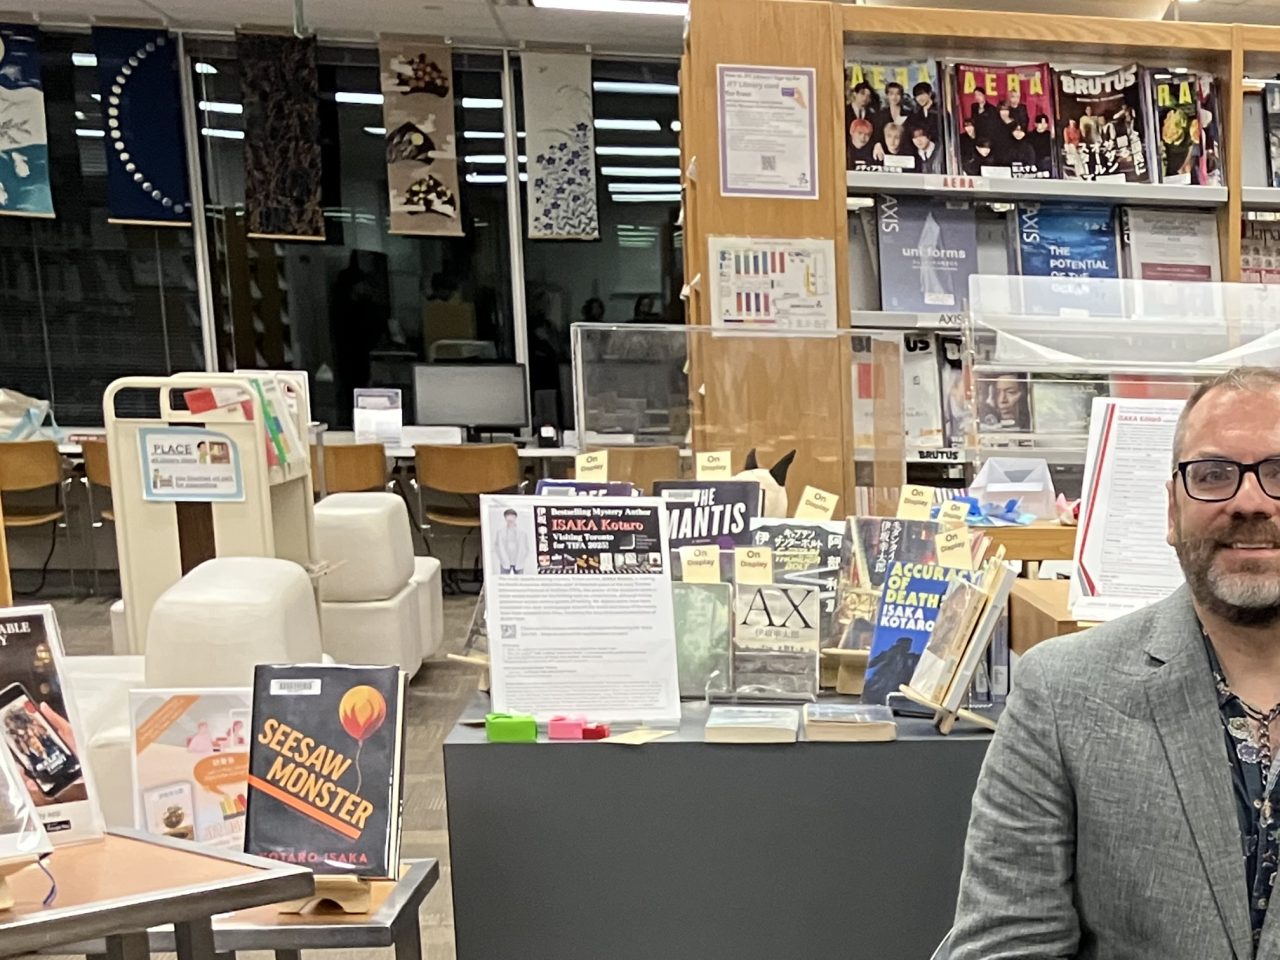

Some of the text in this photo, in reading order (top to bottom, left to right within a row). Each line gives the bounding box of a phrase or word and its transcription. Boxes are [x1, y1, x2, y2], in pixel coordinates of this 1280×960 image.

[963, 71, 1043, 96] AERA
[1060, 65, 1136, 95] BRUTUS
[942, 177, 975, 189] AERA
[880, 194, 899, 233] AXIS
[1050, 246, 1070, 256] THE
[1050, 259, 1109, 270] POTENTIAL
[939, 314, 962, 325] AXIS
[153, 444, 192, 455] PLACE
[918, 450, 959, 460] BRUTUS
[586, 455, 598, 463] On
[707, 455, 720, 463] On
[580, 463, 603, 472] Display
[701, 464, 727, 473] Display
[814, 493, 826, 502] On
[911, 489, 924, 497] On
[551, 508, 651, 518] Bestselling Mystery Author
[552, 519, 644, 531] ISAKA Kotaro
[666, 502, 747, 539] MANTIS
[553, 533, 614, 542] Visiting Toronto
[887, 521, 902, 562] モダンタイ
[945, 533, 958, 542] On
[553, 541, 564, 549] for
[566, 542, 586, 550] TIFA
[941, 542, 965, 553] Display
[694, 549, 707, 557] On
[747, 550, 760, 558] On
[890, 561, 984, 583] ACCURACY
[888, 575, 911, 592] OF
[885, 590, 940, 609] DEATH
[740, 587, 814, 630] AX
[882, 605, 924, 620] ISAKA
[0, 622, 31, 634] ABLE
[880, 616, 935, 632] KOTARO
[258, 718, 352, 782] SEESAW
[266, 756, 374, 829] MONSTER
[260, 851, 368, 864] KOTARO ISAKA
